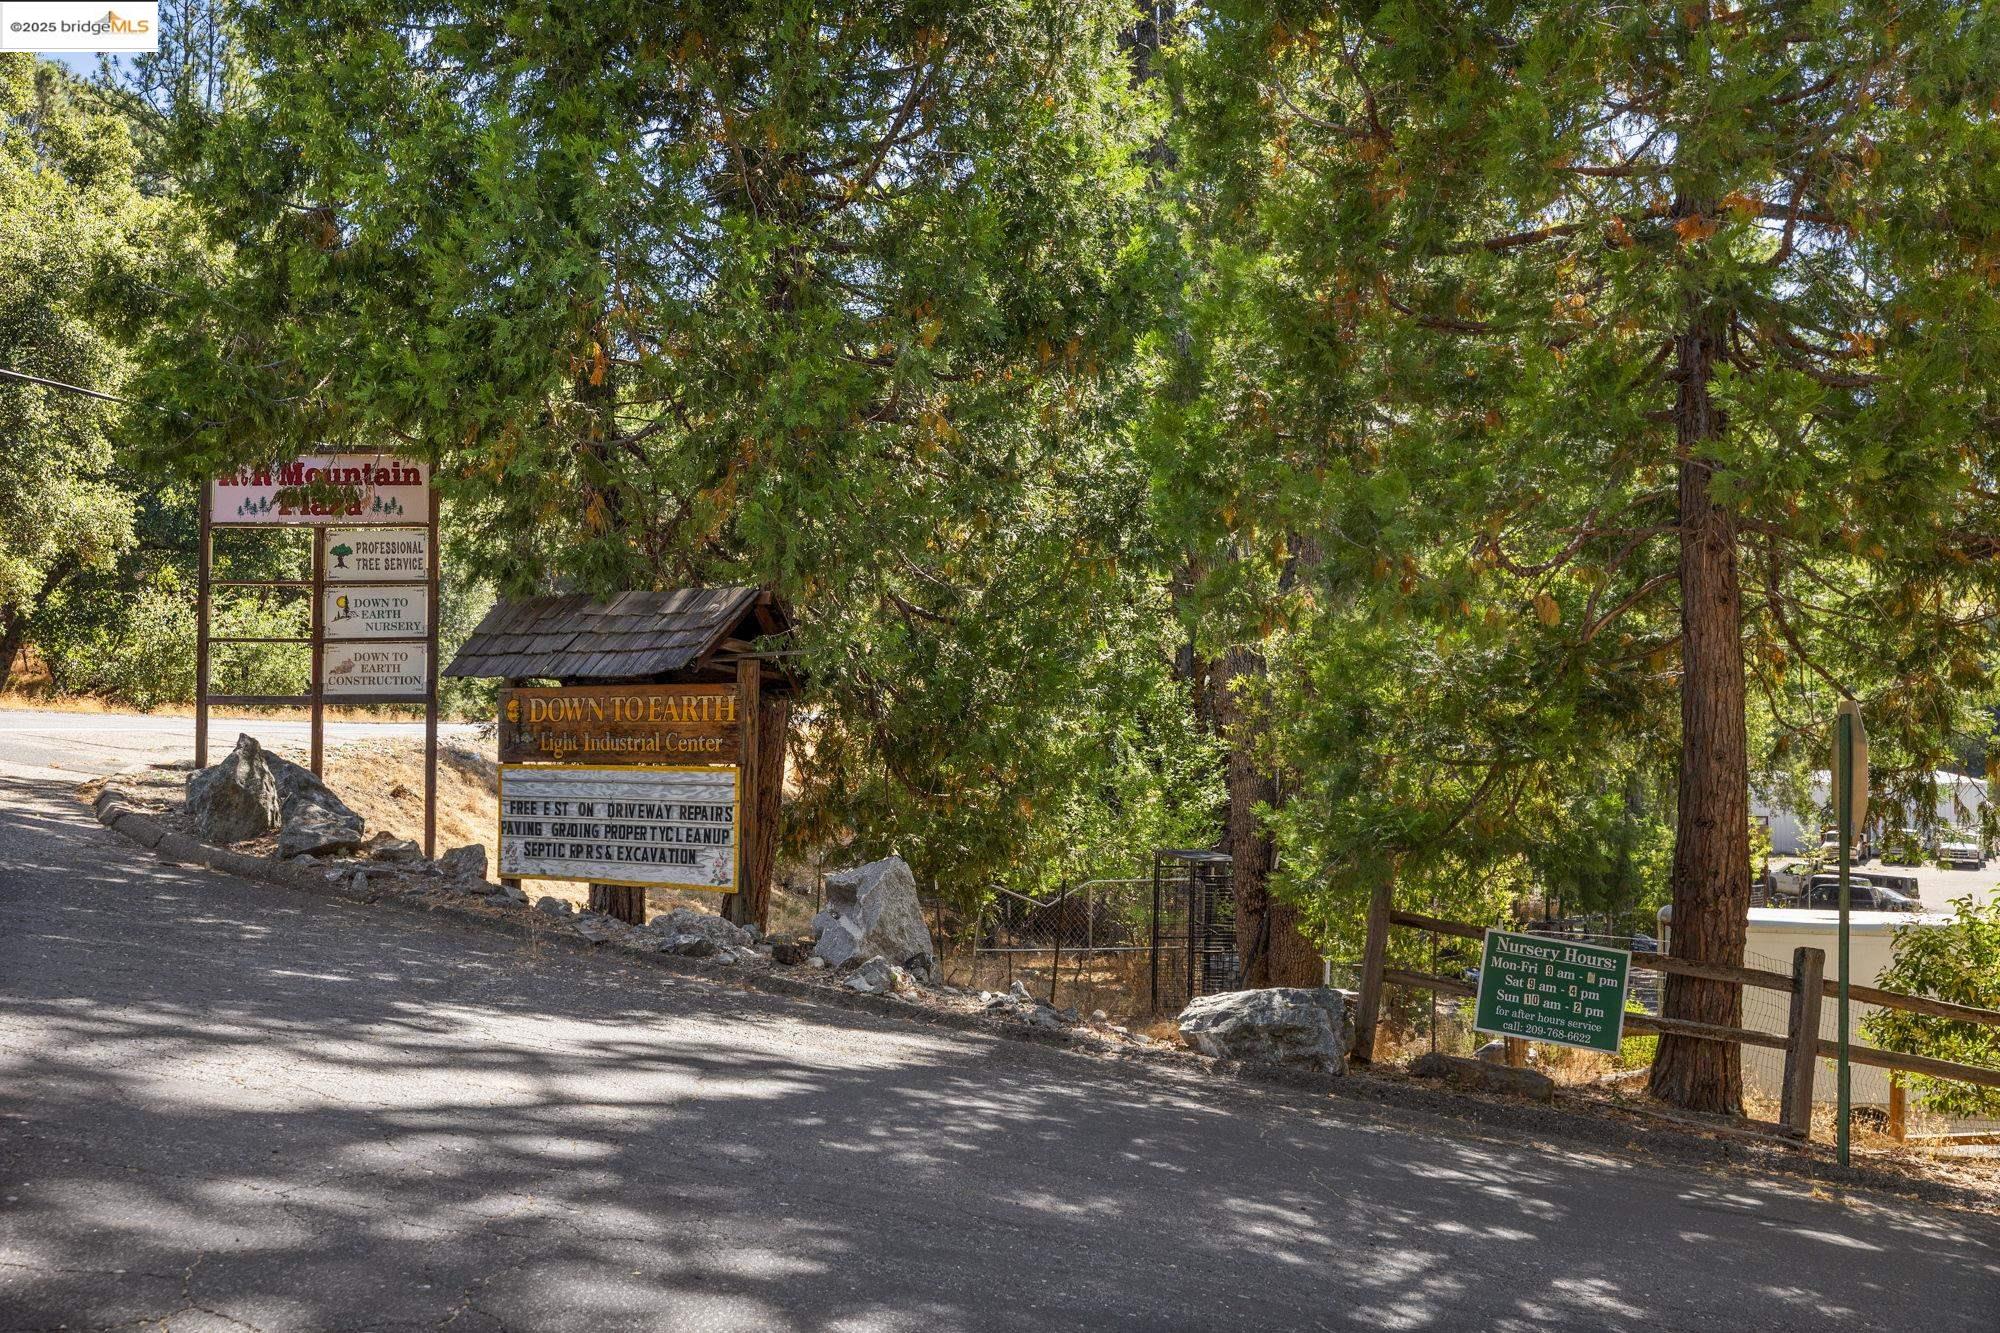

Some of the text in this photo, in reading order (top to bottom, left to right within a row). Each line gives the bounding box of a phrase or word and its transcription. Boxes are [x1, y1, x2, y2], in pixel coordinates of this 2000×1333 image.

[279, 462, 422, 486] Mountain
[279, 491, 363, 516] aza
[356, 541, 424, 554] PROFESSIONAL
[356, 558, 424, 571] TREE SERVICE
[354, 598, 408, 608] DOWN TO
[361, 610, 401, 619] EARTH
[365, 621, 421, 631] NURSERY
[354, 652, 408, 662] DOWN TO
[361, 664, 401, 673] EARTH
[328, 676, 422, 686] CONSTRUCTION
[528, 695, 736, 723] DOWN TO EARTH
[540, 731, 722, 759] Light Industrial Center
[510, 801, 537, 815] FREE
[578, 802, 594, 817] ON
[607, 804, 672, 821] DRIVEWAY
[679, 805, 733, 822] REPAIRS
[501, 821, 542, 836] PAVING
[551, 823, 599, 838] GRADING
[524, 841, 565, 858] SEPTIC
[616, 845, 696, 864] EXCAVATION
[1496, 936, 1617, 970] Nursery Hours:
[1490, 955, 1538, 974] Mon-Fri
[1556, 970, 1575, 981] am
[1599, 976, 1618, 988] pm
[1504, 974, 1524, 988] Sat
[1538, 983, 1557, 993] am
[1580, 989, 1600, 1001] pm
[1496, 989, 1520, 1004] Sun
[1524, 994, 1539, 1005] 10
[1543, 998, 1561, 1010] am
[1584, 1006, 1604, 1018] pm
[1495, 1005, 1602, 1033] for after hours service
[1502, 1021, 1591, 1044] call: 209-768-6622
